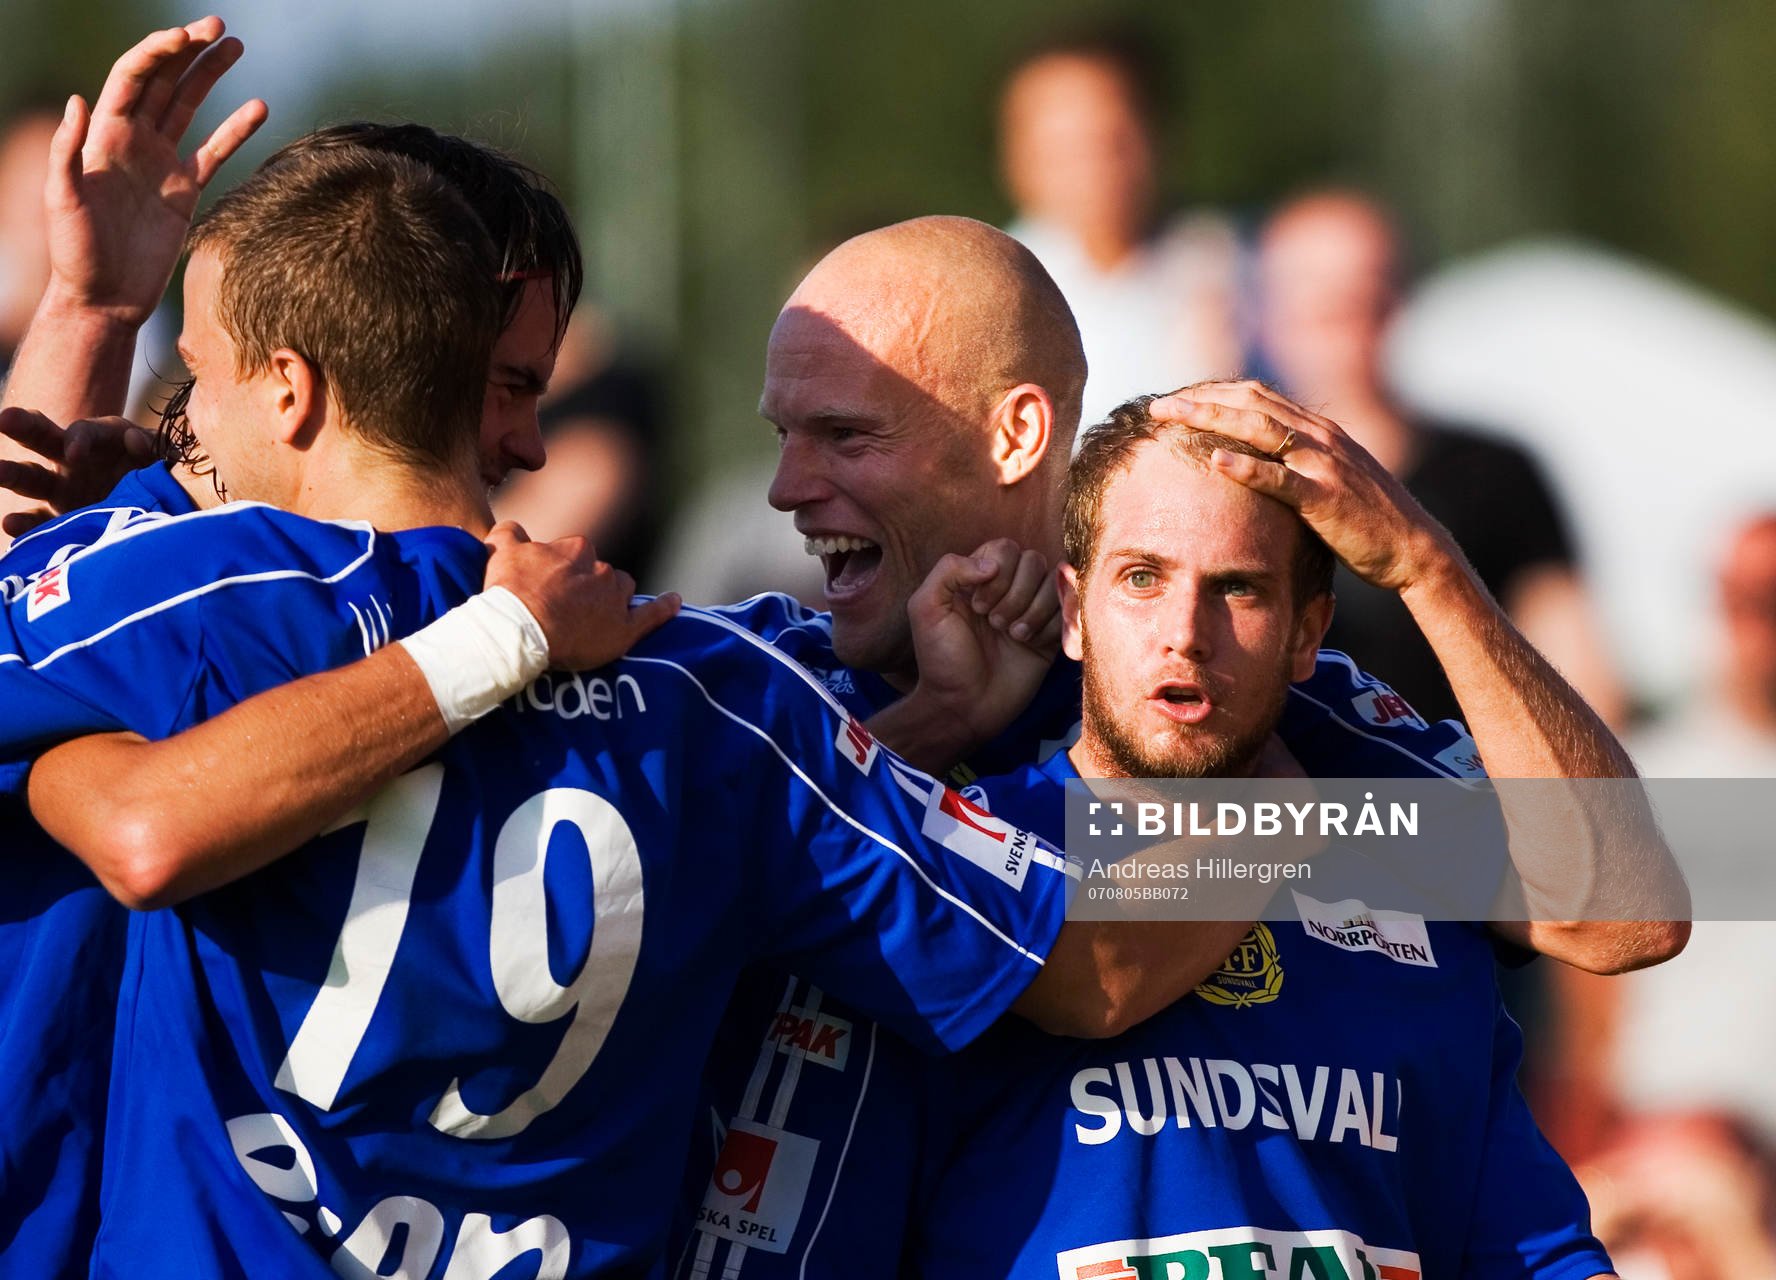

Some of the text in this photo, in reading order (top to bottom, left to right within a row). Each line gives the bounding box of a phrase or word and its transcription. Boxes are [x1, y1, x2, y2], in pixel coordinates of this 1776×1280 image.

[1308, 919, 1429, 962] NORRPORTEN
[1070, 1057, 1401, 1152] SUNDSVAL
[737, 1219, 777, 1242] SPEL
